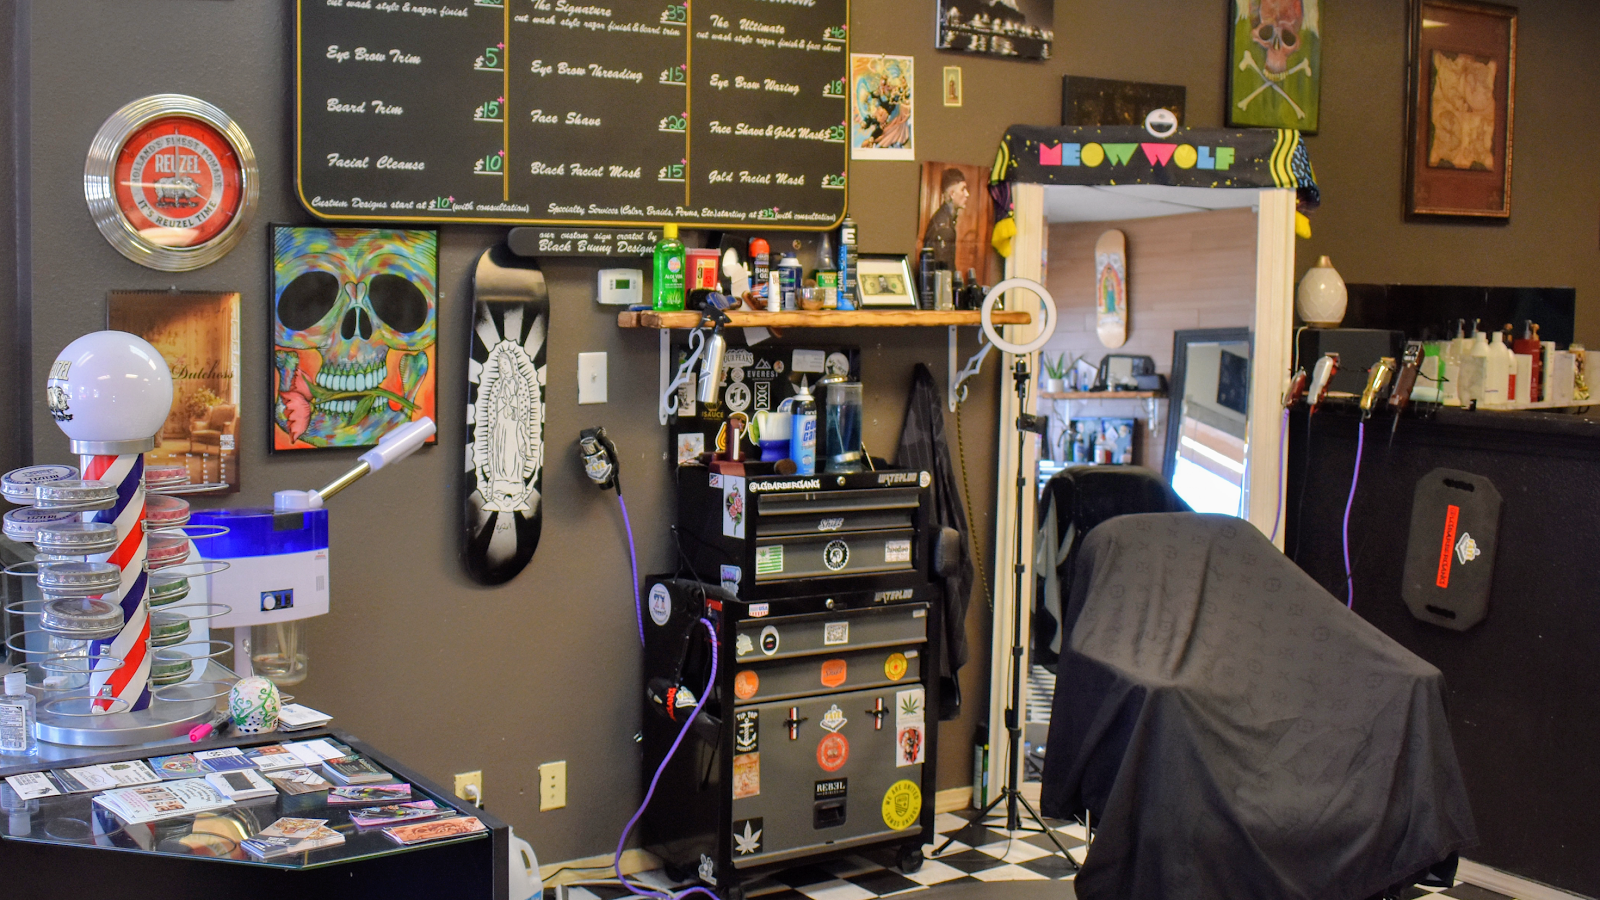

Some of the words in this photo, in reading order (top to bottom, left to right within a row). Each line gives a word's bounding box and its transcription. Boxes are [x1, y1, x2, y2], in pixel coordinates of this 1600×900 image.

[346, 0, 372, 9] wash
[375, 1, 400, 13] style
[402, 1, 410, 12] &
[411, 5, 437, 16] razor
[439, 5, 469, 17] finish
[532, 0, 551, 11] The
[555, 0, 612, 17] Signature
[514, 14, 529, 22] cut
[532, 15, 556, 25] wash
[560, 18, 581, 29] style
[583, 21, 605, 31] razor
[607, 22, 631, 32] finish
[662, 27, 681, 36] trim
[709, 14, 730, 28] The
[739, 18, 785, 34] Ultimate
[696, 31, 709, 39] cut
[711, 31, 732, 41] wash
[734, 34, 753, 46] style
[755, 38, 775, 47] razor
[777, 38, 798, 48] finish
[806, 41, 821, 51] face
[822, 43, 842, 52] shave
[326, 45, 350, 63] Eye
[355, 47, 386, 62] Brow
[389, 49, 421, 65] Trim
[531, 59, 552, 77] Eye
[557, 62, 586, 76] Brow
[588, 64, 643, 83] Threading
[709, 74, 730, 90] Eye
[735, 75, 760, 90] Brow
[764, 79, 800, 96] Waxing
[327, 98, 365, 114] Beard
[371, 100, 403, 115] Trim
[530, 109, 558, 124] Face
[565, 112, 601, 126] Shave
[709, 121, 731, 134] Face
[735, 123, 764, 136] Shave
[774, 127, 796, 140] Gold
[798, 128, 824, 140] Mask
[155, 153, 201, 174] REUZEL
[327, 153, 369, 169] Facial
[376, 155, 425, 171] Cleanse
[1039, 142, 1139, 167] MEOW
[1140, 142, 1235, 171] WOLF
[203, 148, 223, 188] POMADE
[531, 161, 565, 176] Black
[570, 163, 604, 177] Facial
[609, 165, 641, 179] Mask
[709, 170, 734, 184] Gold
[739, 171, 771, 184] Facial
[776, 173, 804, 186] Mask
[138, 199, 154, 218] IT'S
[156, 217, 194, 229] REUZEL
[197, 201, 217, 223] TIME
[311, 196, 348, 208] Custom
[351, 197, 388, 210] Designs
[390, 200, 414, 210] start
[416, 201, 427, 210] at
[452, 200, 473, 212] (with
[476, 203, 530, 213] consultation)
[547, 203, 585, 216] Specialty
[588, 204, 618, 215] Services
[620, 205, 644, 216] (Color,
[646, 206, 674, 217] Braids,
[675, 206, 699, 218] Perms,
[717, 209, 746, 220] starting
[748, 210, 757, 218] at
[794, 213, 836, 222] consultation)
[560, 231, 589, 240] custom
[593, 231, 612, 243] sign
[616, 231, 644, 241] created
[647, 231, 657, 242] by
[538, 239, 571, 252] Black
[577, 240, 612, 255] Bunny
